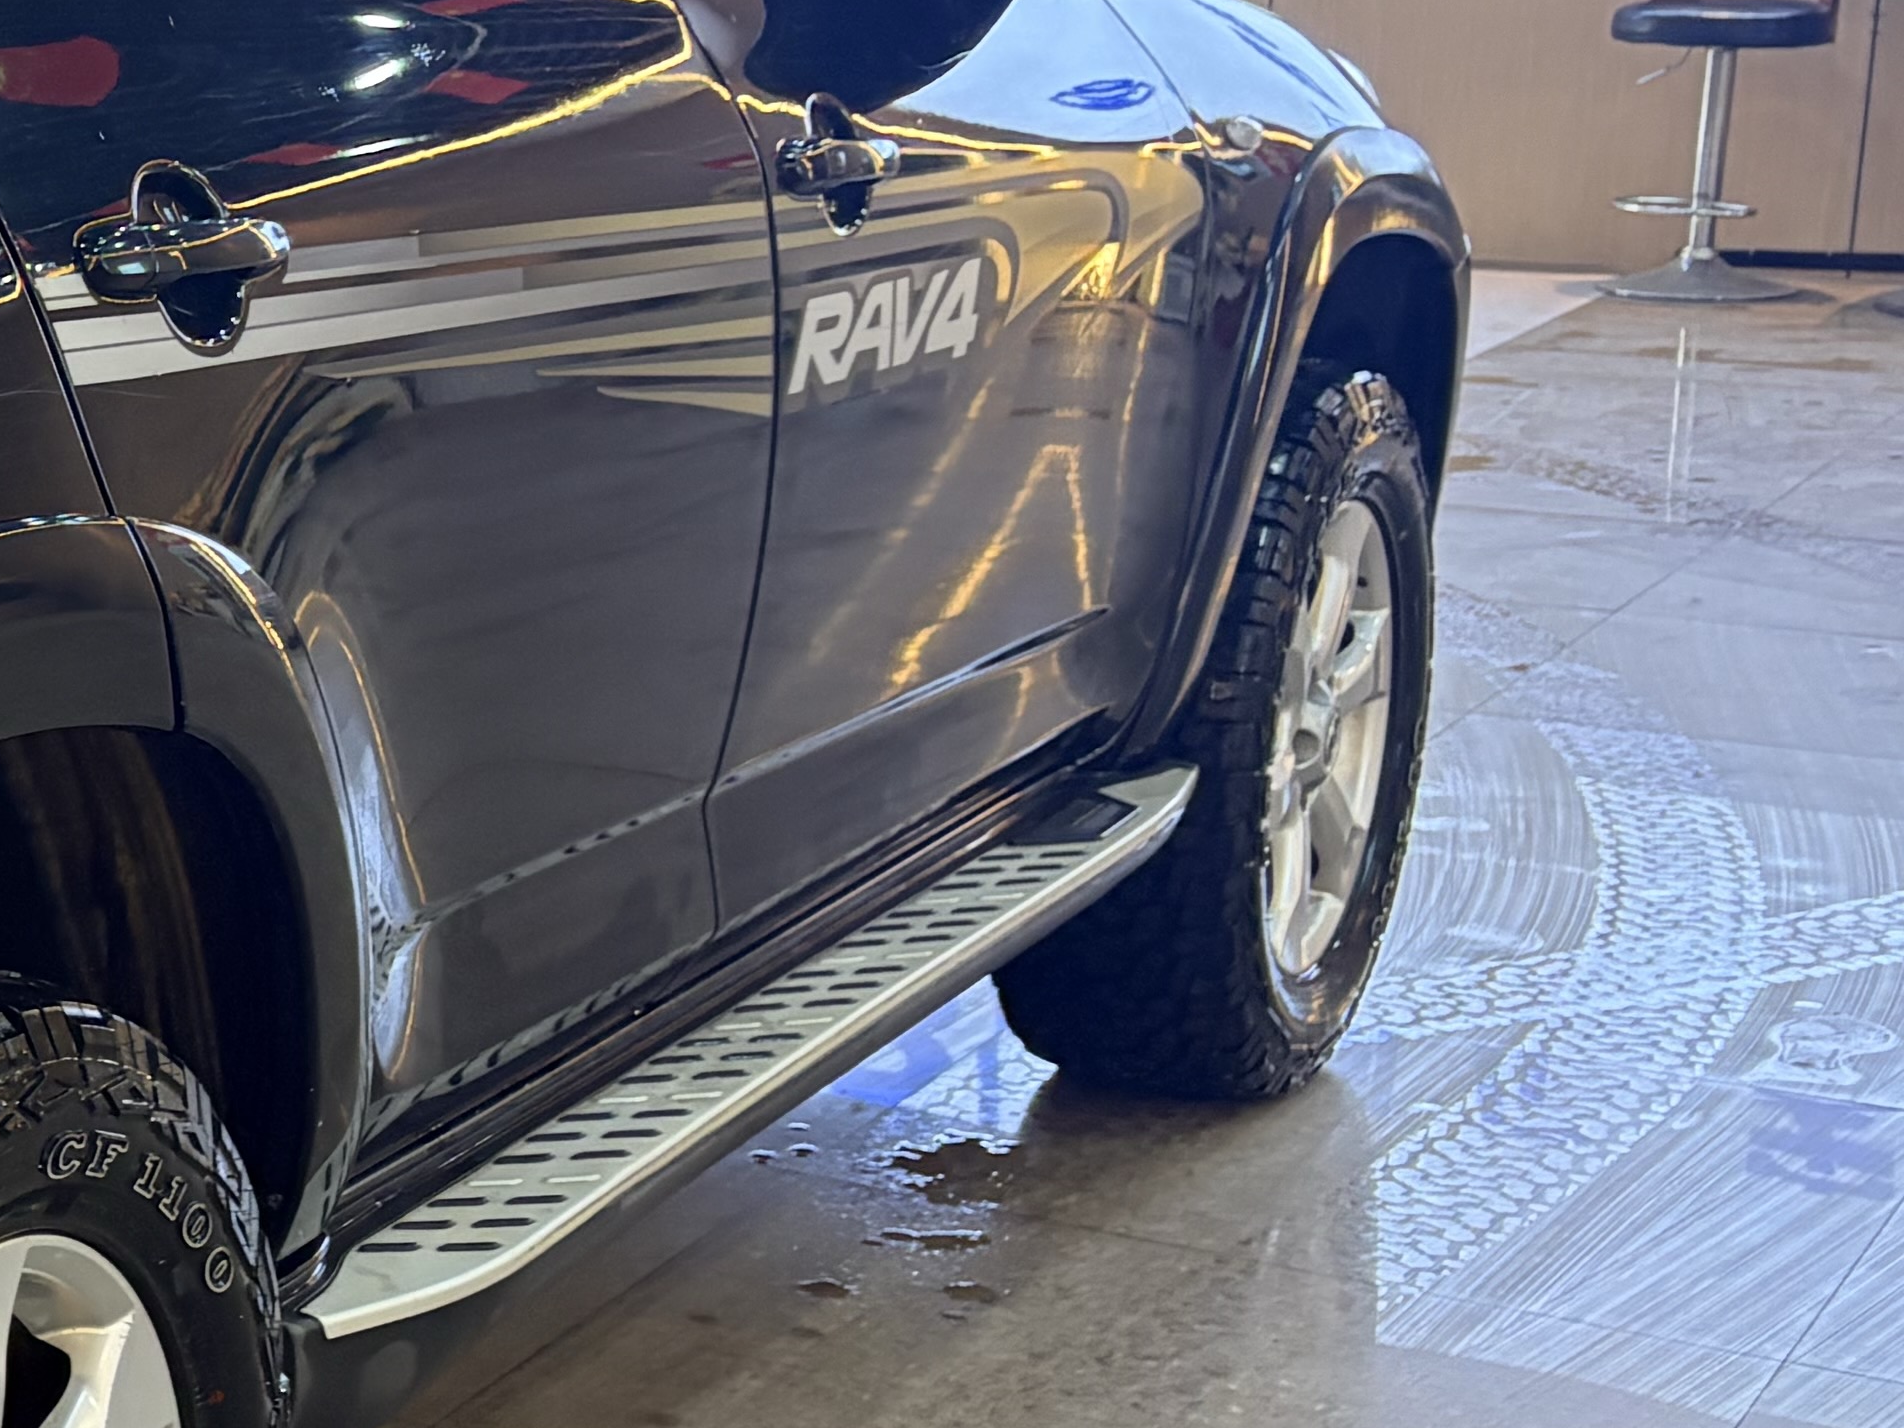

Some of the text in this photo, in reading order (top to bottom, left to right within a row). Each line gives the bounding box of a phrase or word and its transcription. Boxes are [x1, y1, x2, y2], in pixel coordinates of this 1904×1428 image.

[787, 258, 981, 396] RAV4
[42, 1128, 237, 1295] CF 1100
